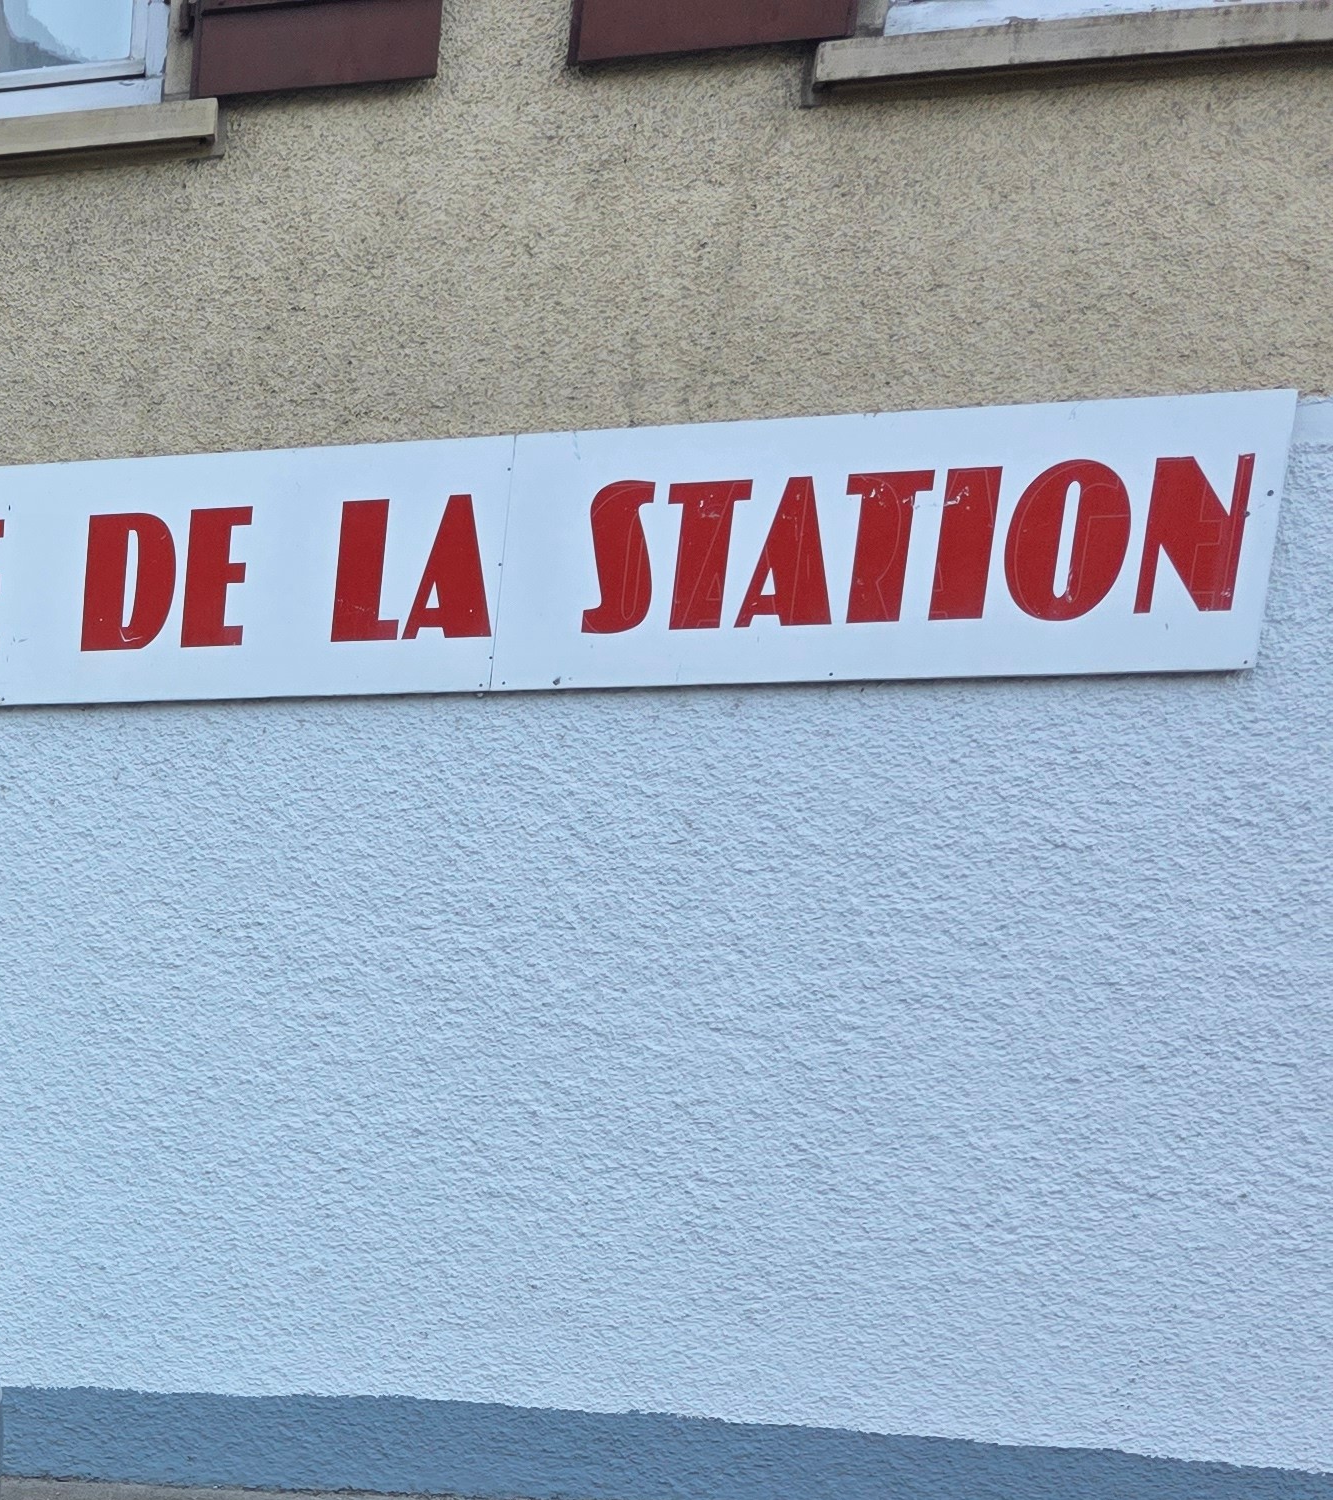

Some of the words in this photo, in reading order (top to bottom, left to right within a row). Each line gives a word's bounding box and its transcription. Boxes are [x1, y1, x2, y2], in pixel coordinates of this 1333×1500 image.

[82, 506, 253, 652] DE
[332, 493, 492, 642] LA
[583, 452, 1256, 638] STATION
